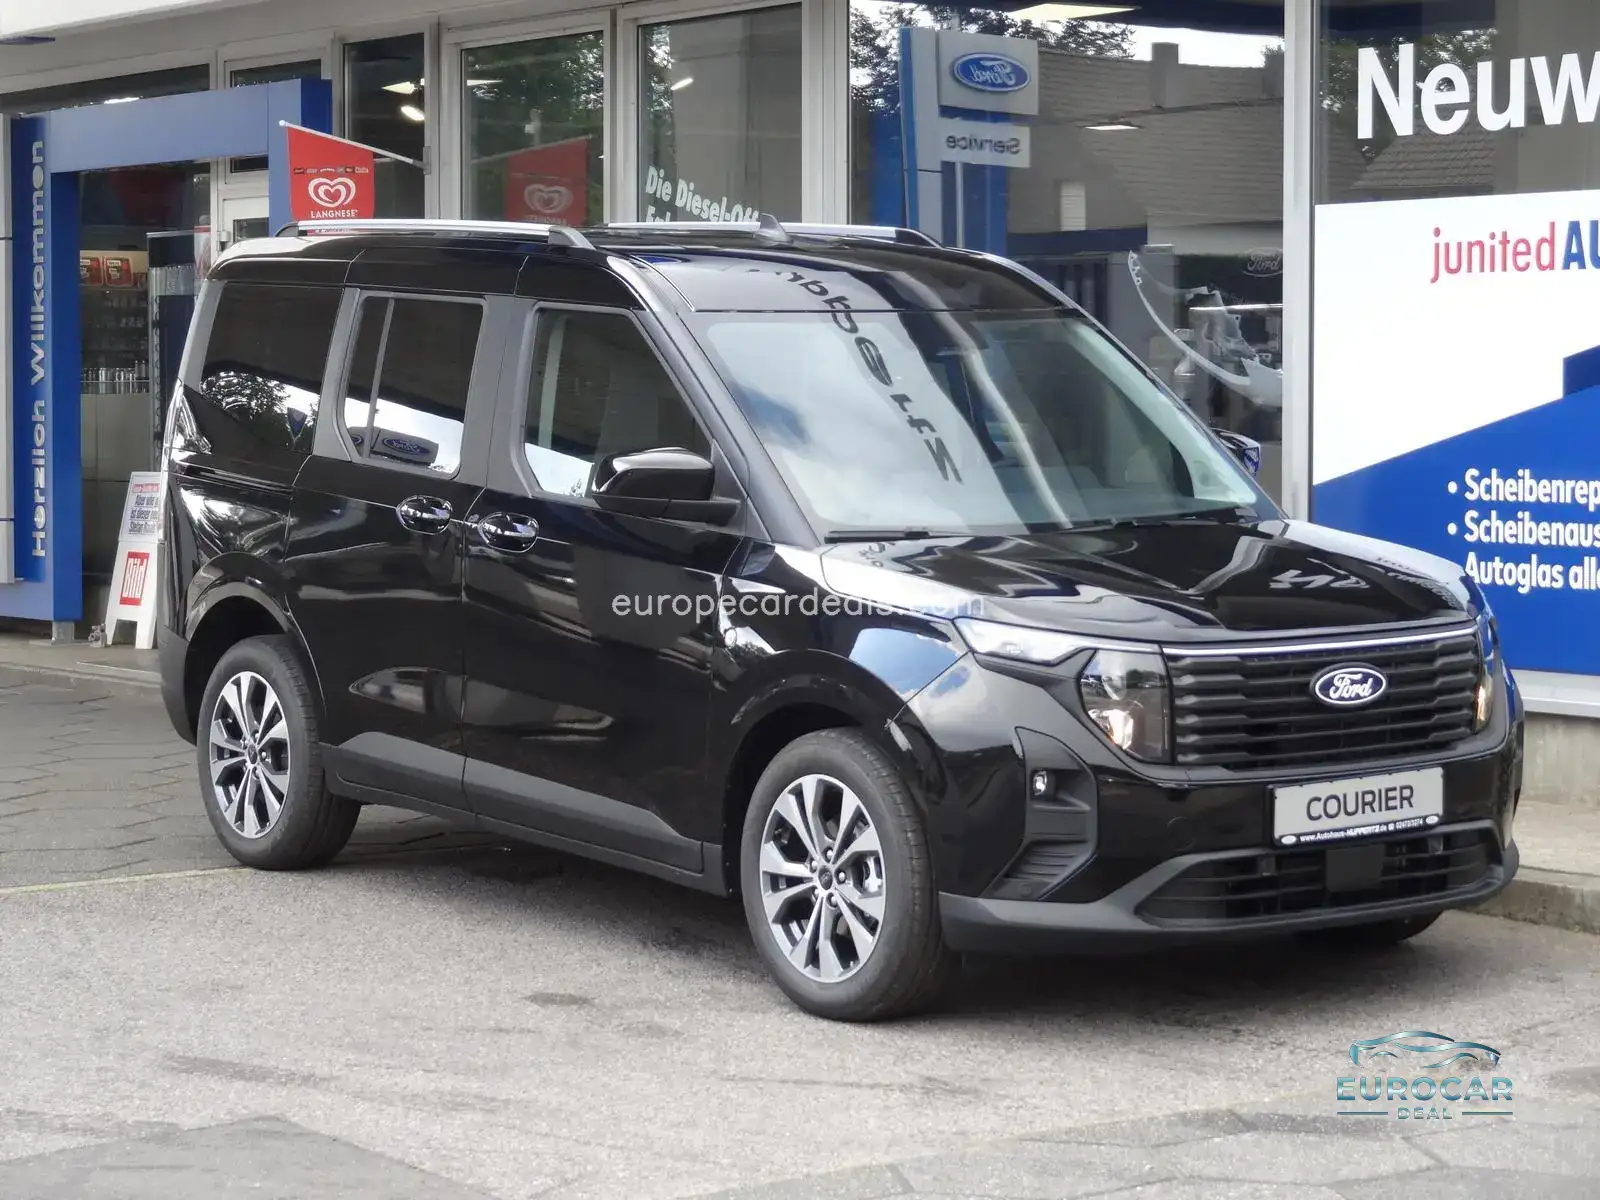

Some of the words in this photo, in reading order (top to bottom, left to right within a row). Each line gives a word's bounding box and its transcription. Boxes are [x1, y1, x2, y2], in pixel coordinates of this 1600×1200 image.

[1357, 42, 1600, 139] Neuw
[645, 165, 672, 202] Die
[310, 209, 356, 219] LANGNESE
[30, 140, 46, 387] Willkommen
[31, 399, 47, 558] Herzlich
[1465, 551, 1564, 594] Autoglas
[1328, 672, 1373, 700] Ford
[1305, 783, 1415, 821] COURIER
